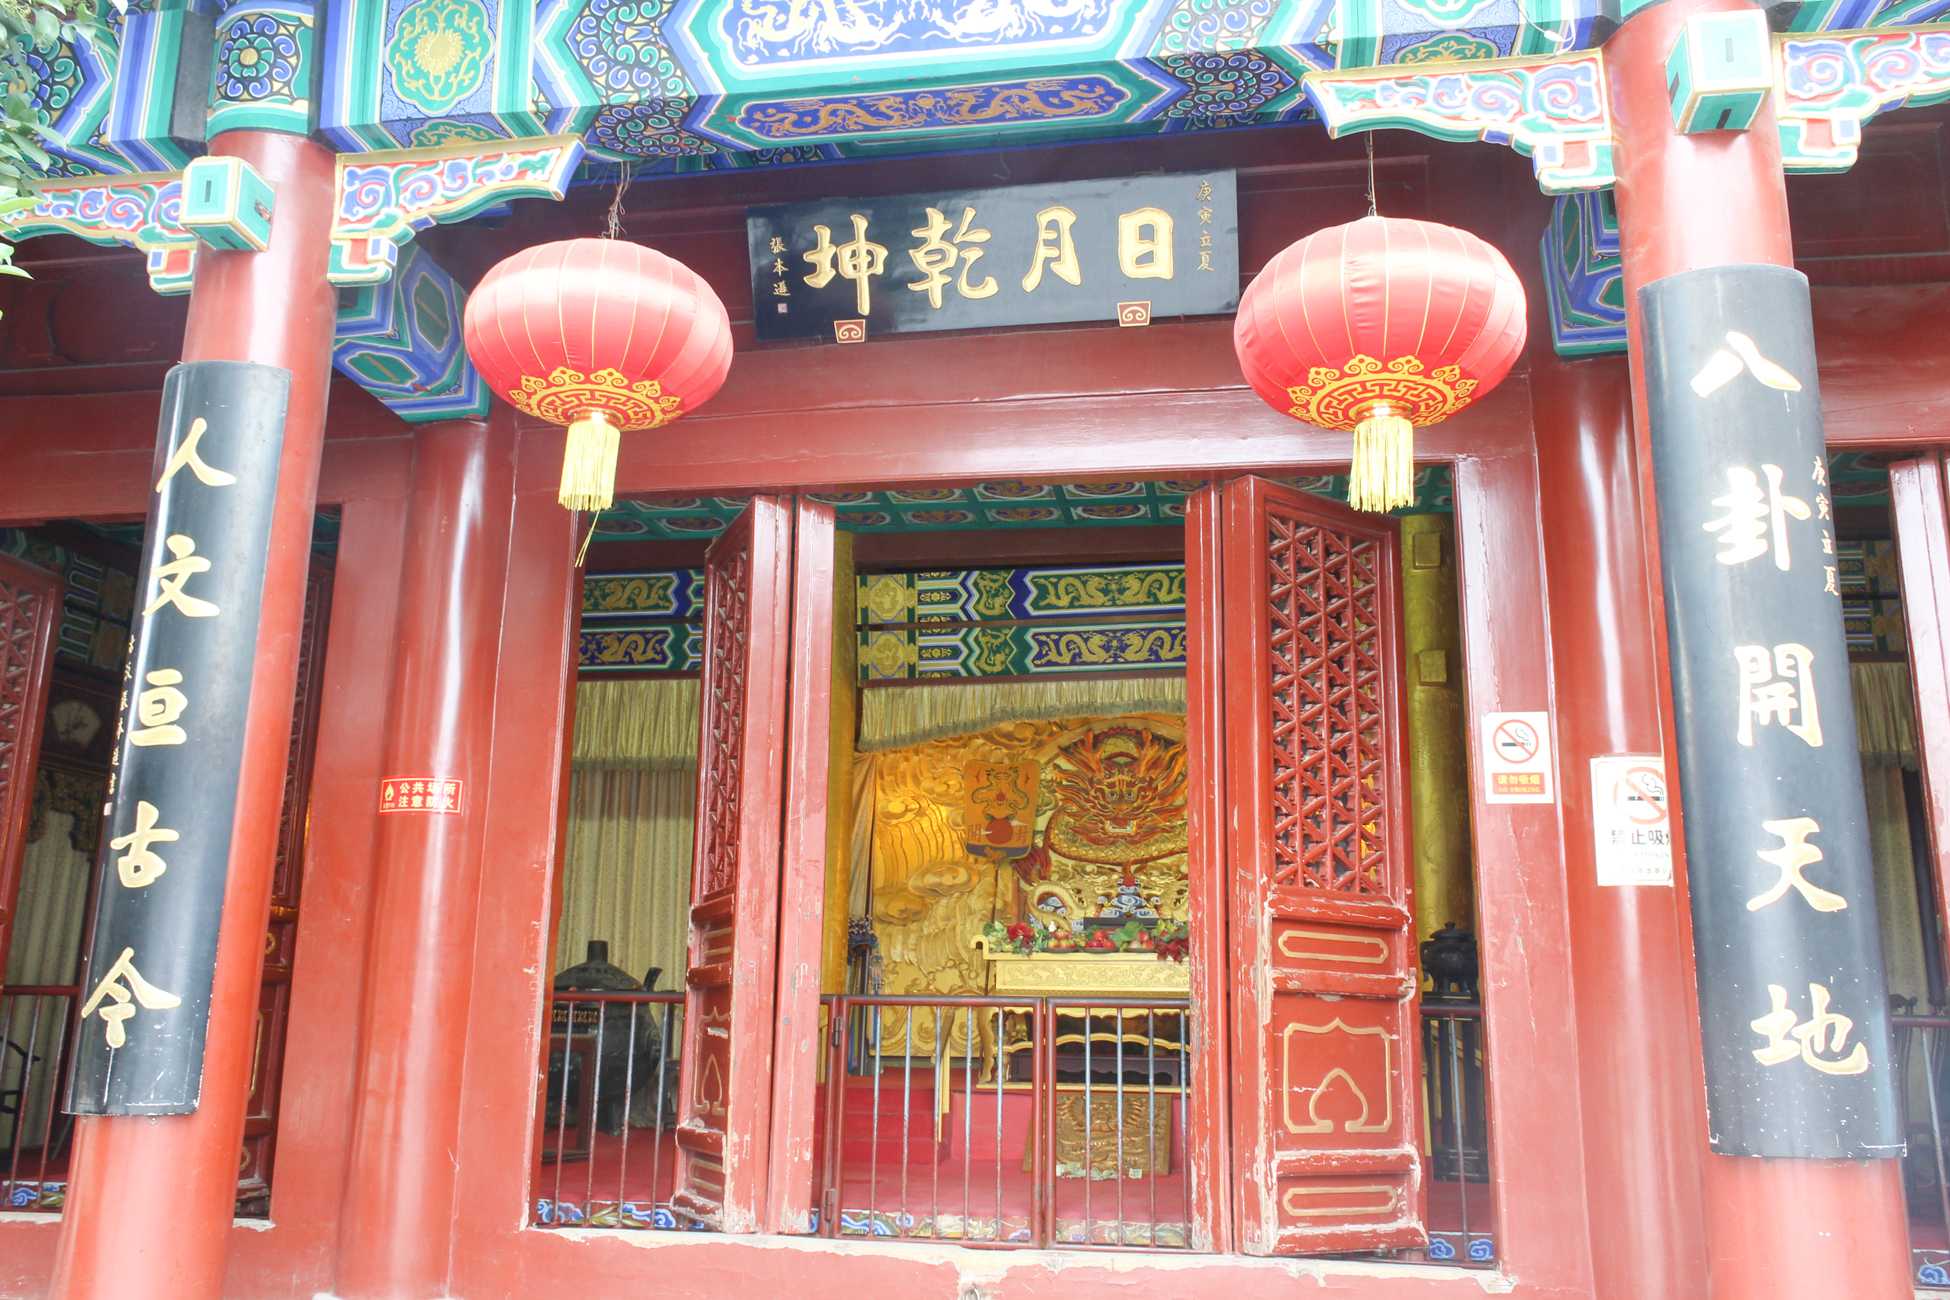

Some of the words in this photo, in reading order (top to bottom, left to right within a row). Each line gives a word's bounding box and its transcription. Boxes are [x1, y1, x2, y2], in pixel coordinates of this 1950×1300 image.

[1196, 180, 1215, 271] 庚寅立夏
[1811, 455, 1840, 596] 庚寅立夏
[1690, 331, 1869, 1075] 八卦開天地
[398, 795, 455, 809] 注意防火
[399, 781, 457, 796] 公共场所
[1497, 774, 1541, 785] 请勿吸烟
